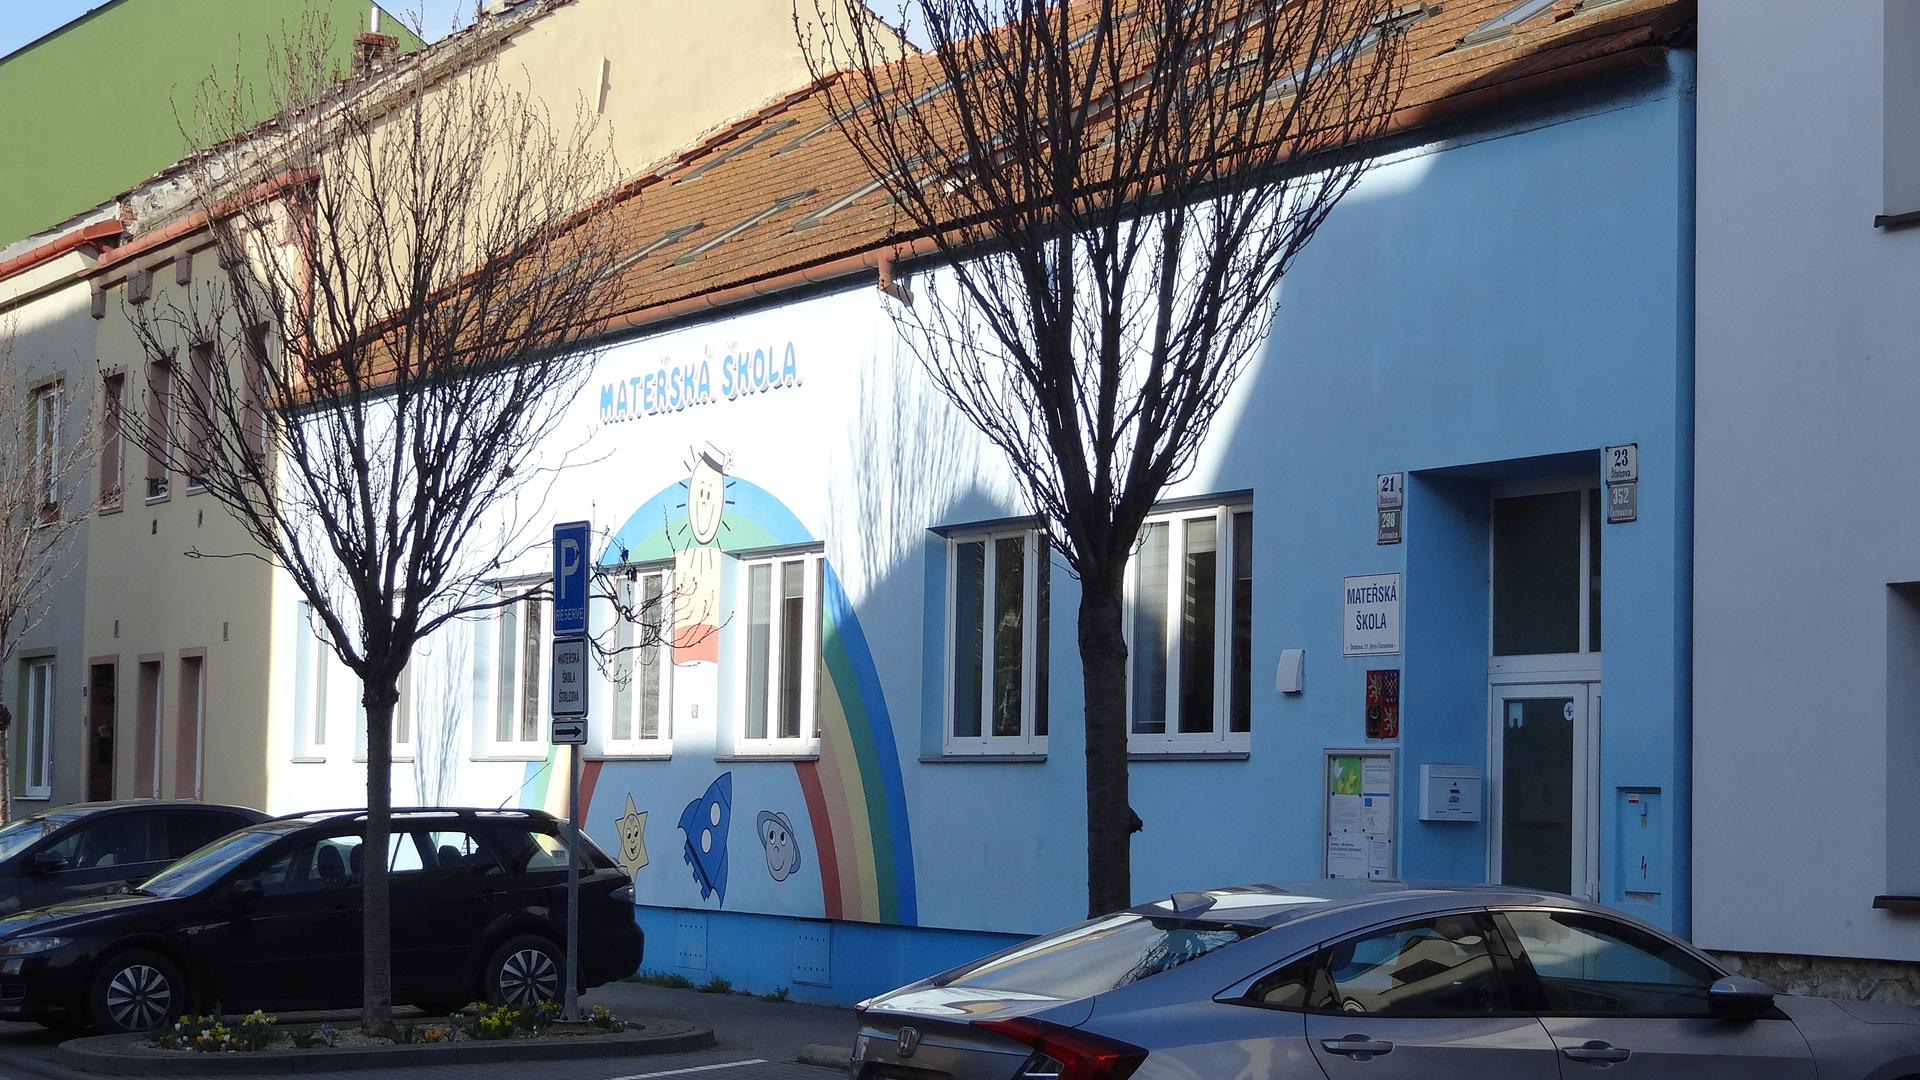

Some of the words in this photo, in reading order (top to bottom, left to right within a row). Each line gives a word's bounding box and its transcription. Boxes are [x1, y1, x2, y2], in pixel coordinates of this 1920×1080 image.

[722, 341, 797, 396] ŠKOLA
[1614, 449, 1629, 467] 23
[1382, 476, 1395, 492] 21
[1613, 487, 1629, 505] 352
[561, 538, 580, 600] P
[1347, 581, 1397, 605] MATEŘSKÁ
[1356, 610, 1387, 631] ŠKOLA
